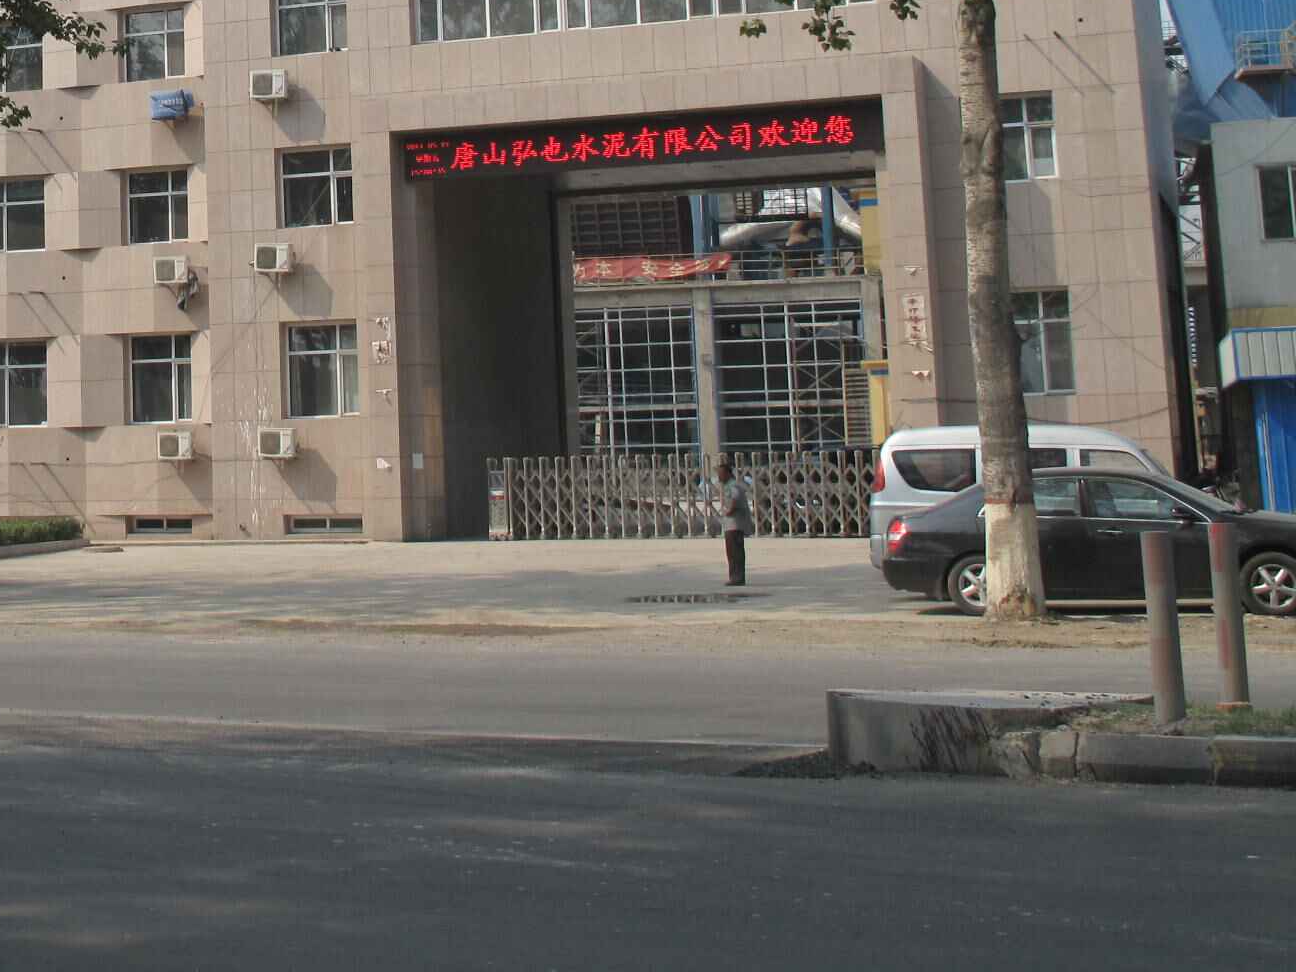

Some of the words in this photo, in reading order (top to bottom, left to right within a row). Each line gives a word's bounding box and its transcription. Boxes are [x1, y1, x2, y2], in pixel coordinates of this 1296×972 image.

[450, 115, 854, 170] 唐山弘也水泥有限公司欢迎您
